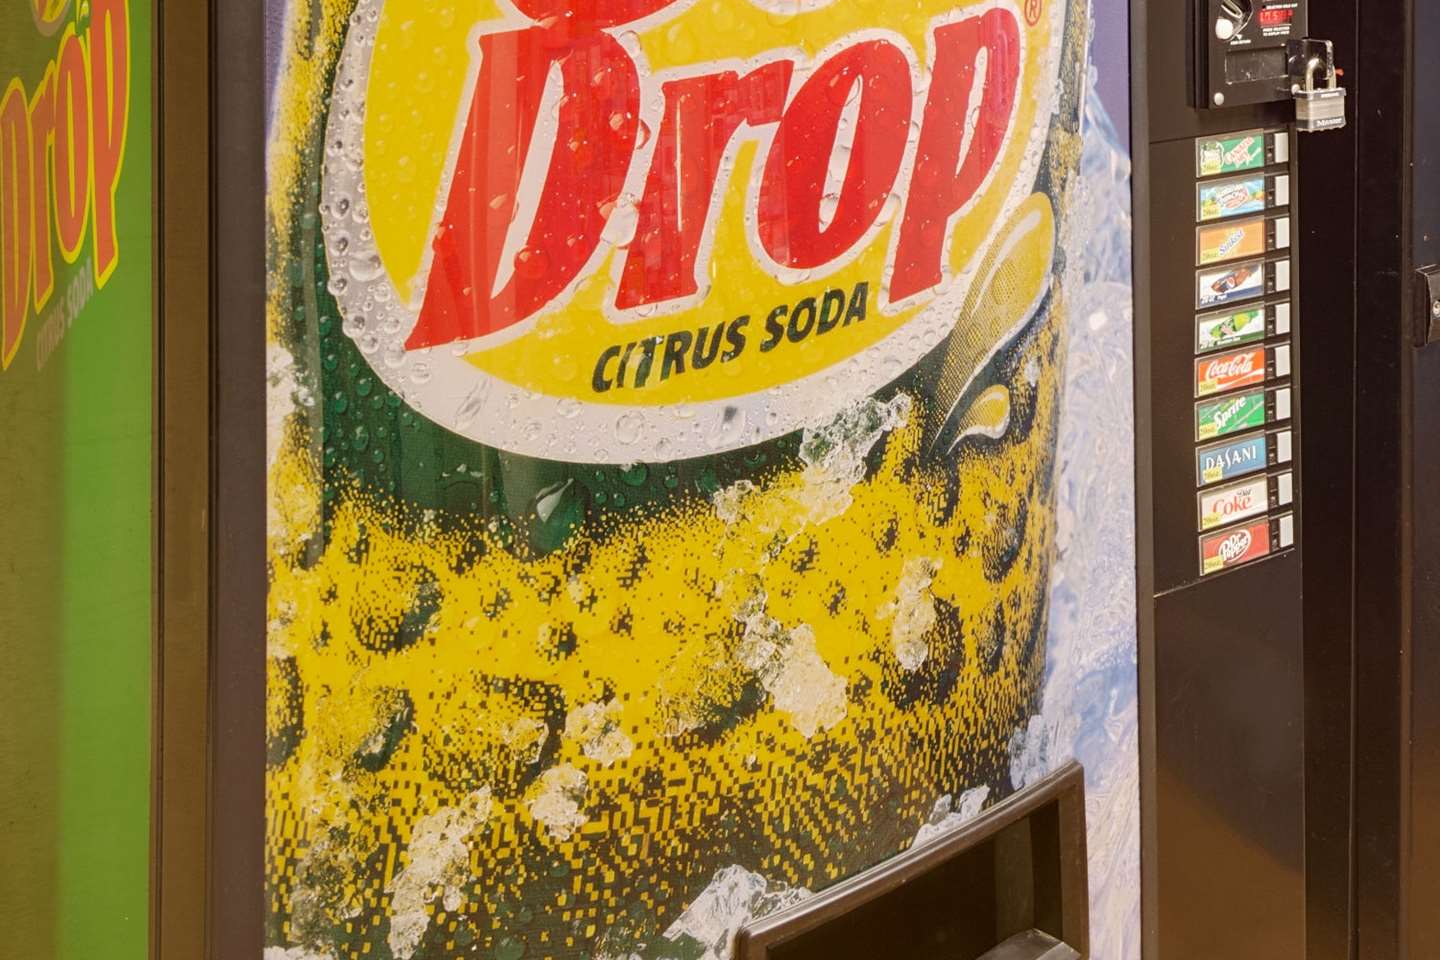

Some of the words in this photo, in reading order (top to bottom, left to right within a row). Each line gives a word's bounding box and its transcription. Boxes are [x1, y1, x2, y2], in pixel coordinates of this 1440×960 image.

[592, 315, 747, 394] CITRUS
[760, 281, 871, 355] SODA
[1206, 352, 1256, 382] Coca-Cola
[1214, 396, 1247, 429] Sprite
[1206, 445, 1257, 471] DASANI
[1212, 495, 1253, 517] Coke
